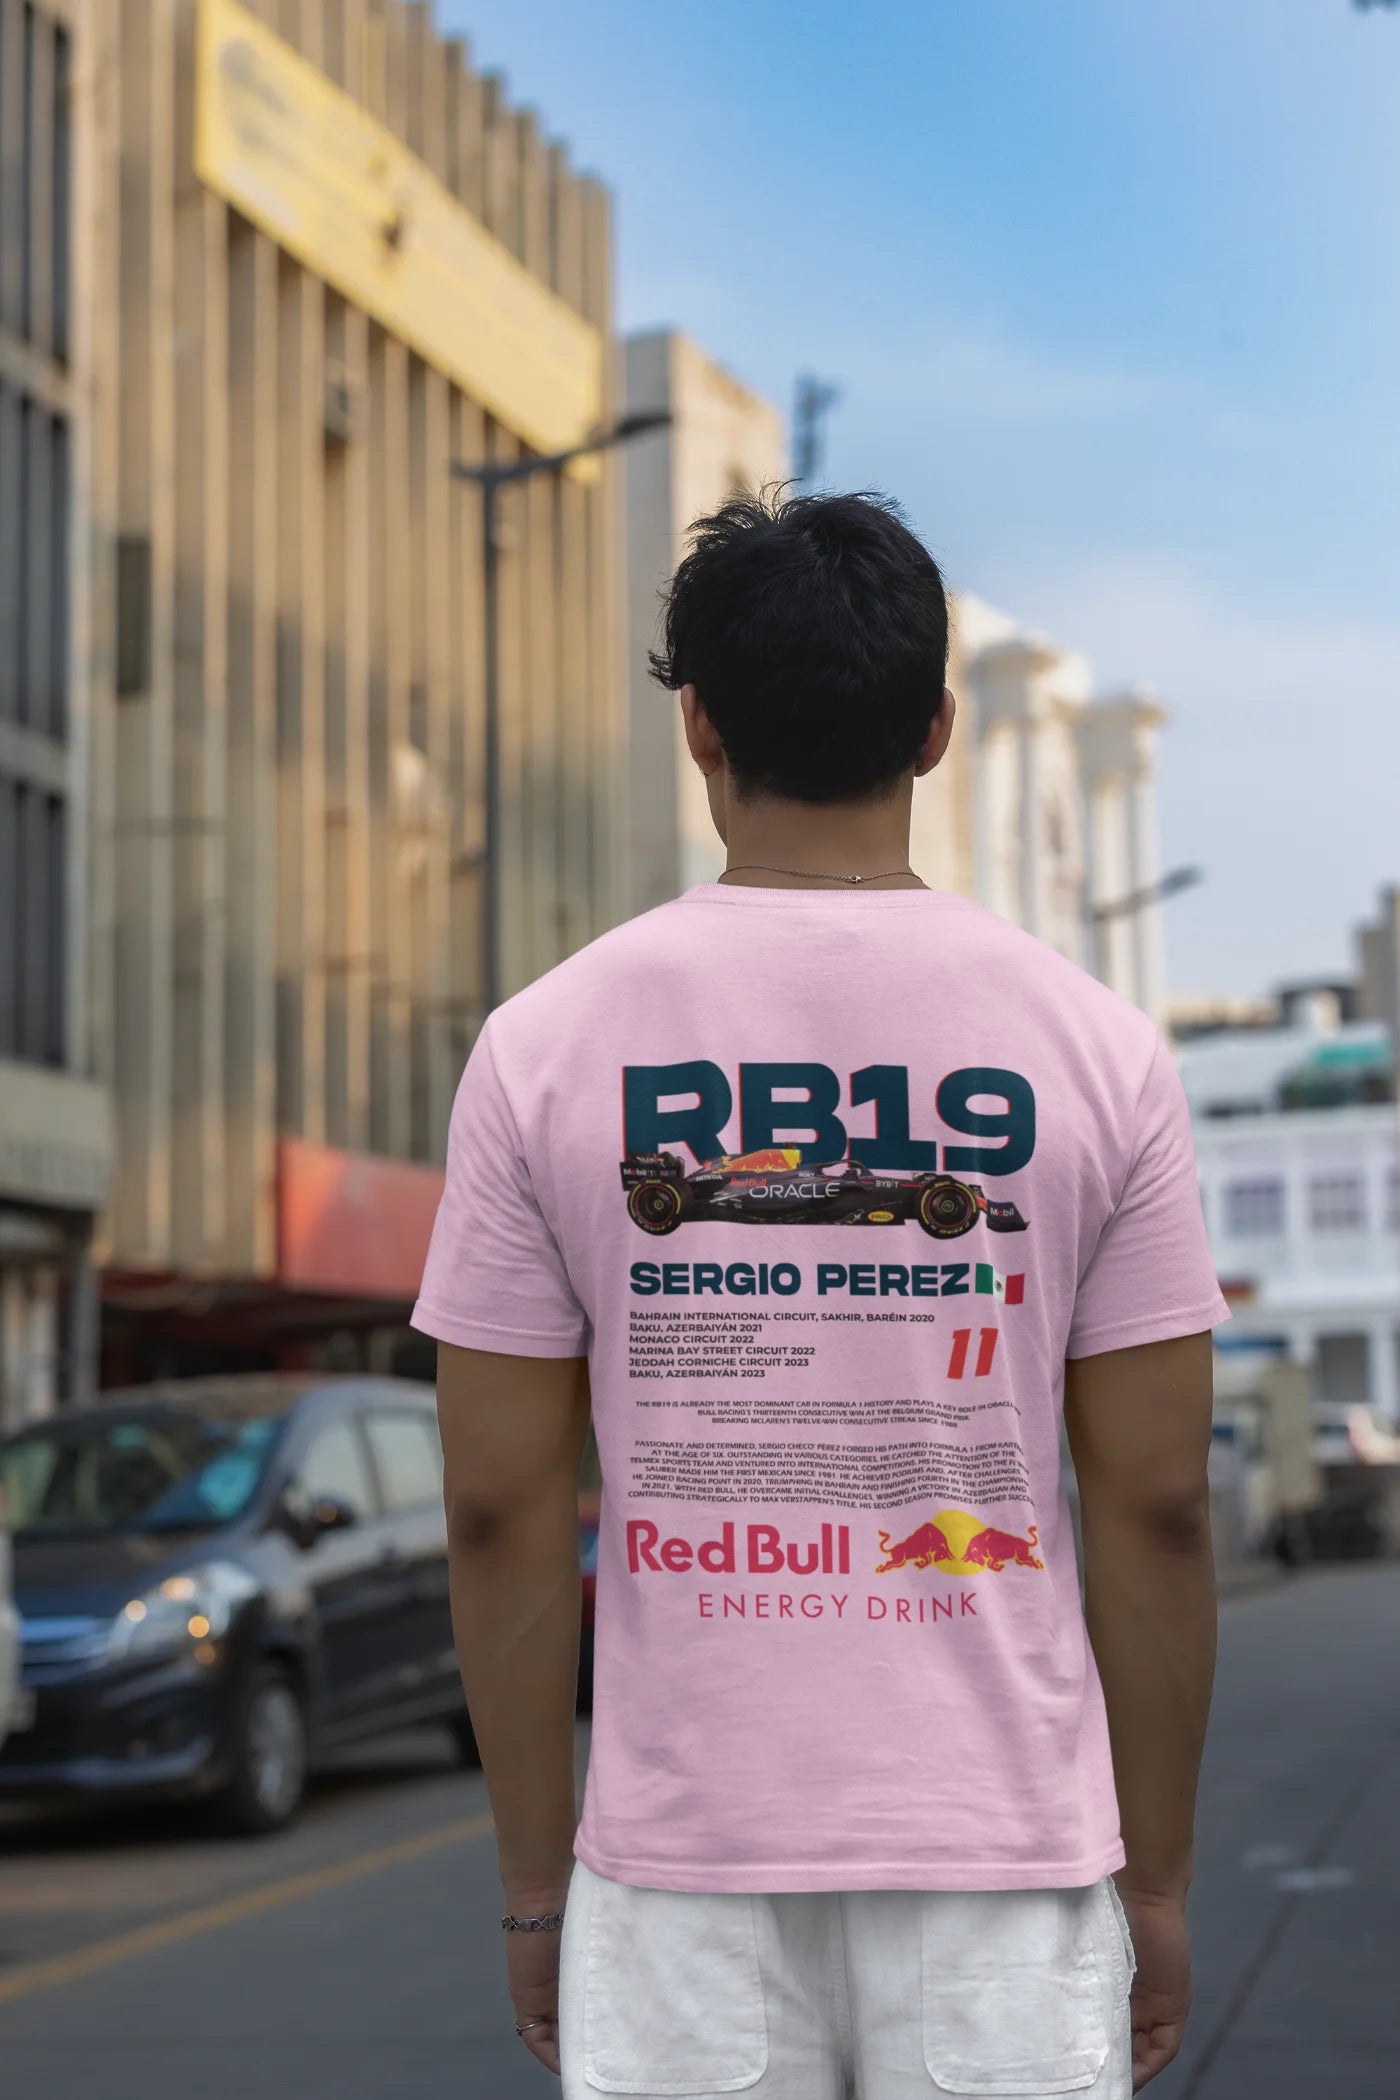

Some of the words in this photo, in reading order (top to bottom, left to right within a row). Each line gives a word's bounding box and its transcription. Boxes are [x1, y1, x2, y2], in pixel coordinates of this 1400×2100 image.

[622, 1060, 1036, 1176] RB19
[749, 1183, 841, 1199] ORACLE
[990, 1208, 1015, 1217] Mobil
[629, 1262, 801, 1296] SERGIO
[817, 1263, 970, 1297] PEREZ
[630, 1311, 681, 1321] BAHRAIN
[683, 1312, 771, 1321] INTERNATIONAL
[773, 1313, 819, 1323] CIRCUIT,
[821, 1313, 865, 1323] SAKHIR,
[866, 1312, 907, 1322] BARÉIN
[909, 1314, 935, 1323] 2020
[629, 1323, 664, 1333] BAKU,
[666, 1322, 737, 1332] AZERBAIYÁN
[739, 1324, 762, 1332] 2021
[629, 1335, 680, 1344] MONACO
[682, 1335, 727, 1344] CIRCUIT
[729, 1336, 755, 1344] 2022
[629, 1347, 674, 1355] MARINA
[677, 1347, 700, 1355] BAY
[702, 1347, 743, 1355] STREET
[745, 1347, 788, 1355] CIRCUIT
[790, 1347, 816, 1355] 2022
[947, 1327, 999, 1379] 11
[628, 1358, 675, 1367] JEDDAH
[677, 1358, 737, 1366] CORNICHE
[738, 1358, 782, 1366] CIRCUIT
[784, 1359, 809, 1367] 2023
[629, 1370, 664, 1379] BAKU,
[666, 1368, 738, 1378] AZERBAIYÁN
[740, 1370, 766, 1378] 2023
[913, 1400, 935, 1408] PLAYS
[925, 1409, 953, 1420] GRAND
[839, 1418, 889, 1426] CONSECUTIVE
[918, 1417, 938, 1425] SINCE
[634, 1441, 684, 1449] PASSIONATE
[686, 1442, 705, 1450] AND
[842, 1445, 874, 1453] FORGED
[888, 1443, 908, 1451] PATH
[930, 1442, 968, 1454] FORMULA
[975, 1443, 997, 1452] FROM
[794, 1452, 829, 1461] VARIOUS
[892, 1451, 927, 1460] CATCHED
[928, 1450, 943, 1458] THE
[944, 1451, 989, 1462] ATTENTION
[989, 1450, 1000, 1458] OF
[1001, 1450, 1016, 1458] THE
[662, 1459, 691, 1467] SPORTS
[797, 1461, 860, 1472] INTERNATIONAL
[931, 1459, 981, 1471] PROMOTION
[981, 1461, 993, 1469] TO
[645, 1466, 677, 1474] SAUBER
[678, 1468, 701, 1476] MADE
[852, 1473, 891, 1481] ACHIEVED
[891, 1468, 925, 1479] PODIUMS
[947, 1469, 973, 1479] AFTER
[645, 1474, 675, 1482] JOINED
[676, 1476, 707, 1485] RACING
[765, 1479, 813, 1487] TRIUMPHING
[824, 1481, 860, 1491] BAHRAIN
[861, 1483, 879, 1491] AND
[880, 1477, 916, 1491] FINISHING
[917, 1475, 949, 1484] FOURTH
[950, 1478, 960, 1486] IN
[961, 1479, 977, 1488] THE
[794, 1488, 821, 1496] INITIAL
[876, 1488, 910, 1501] WINNING
[1009, 1485, 1027, 1493] AND
[628, 1491, 685, 1500] CONTRIBUTING
[686, 1494, 748, 1503] STRATEGICALLY
[872, 1499, 903, 1510] SECOND
[904, 1492, 932, 1505] SEASON
[934, 1492, 973, 1505] PROMISES
[974, 1495, 1007, 1505] FURTHER
[626, 1520, 735, 1574] Red
[747, 1523, 850, 1575] Bull
[699, 1594, 849, 1618] ENERGY
[868, 1592, 978, 1623] DRINK
